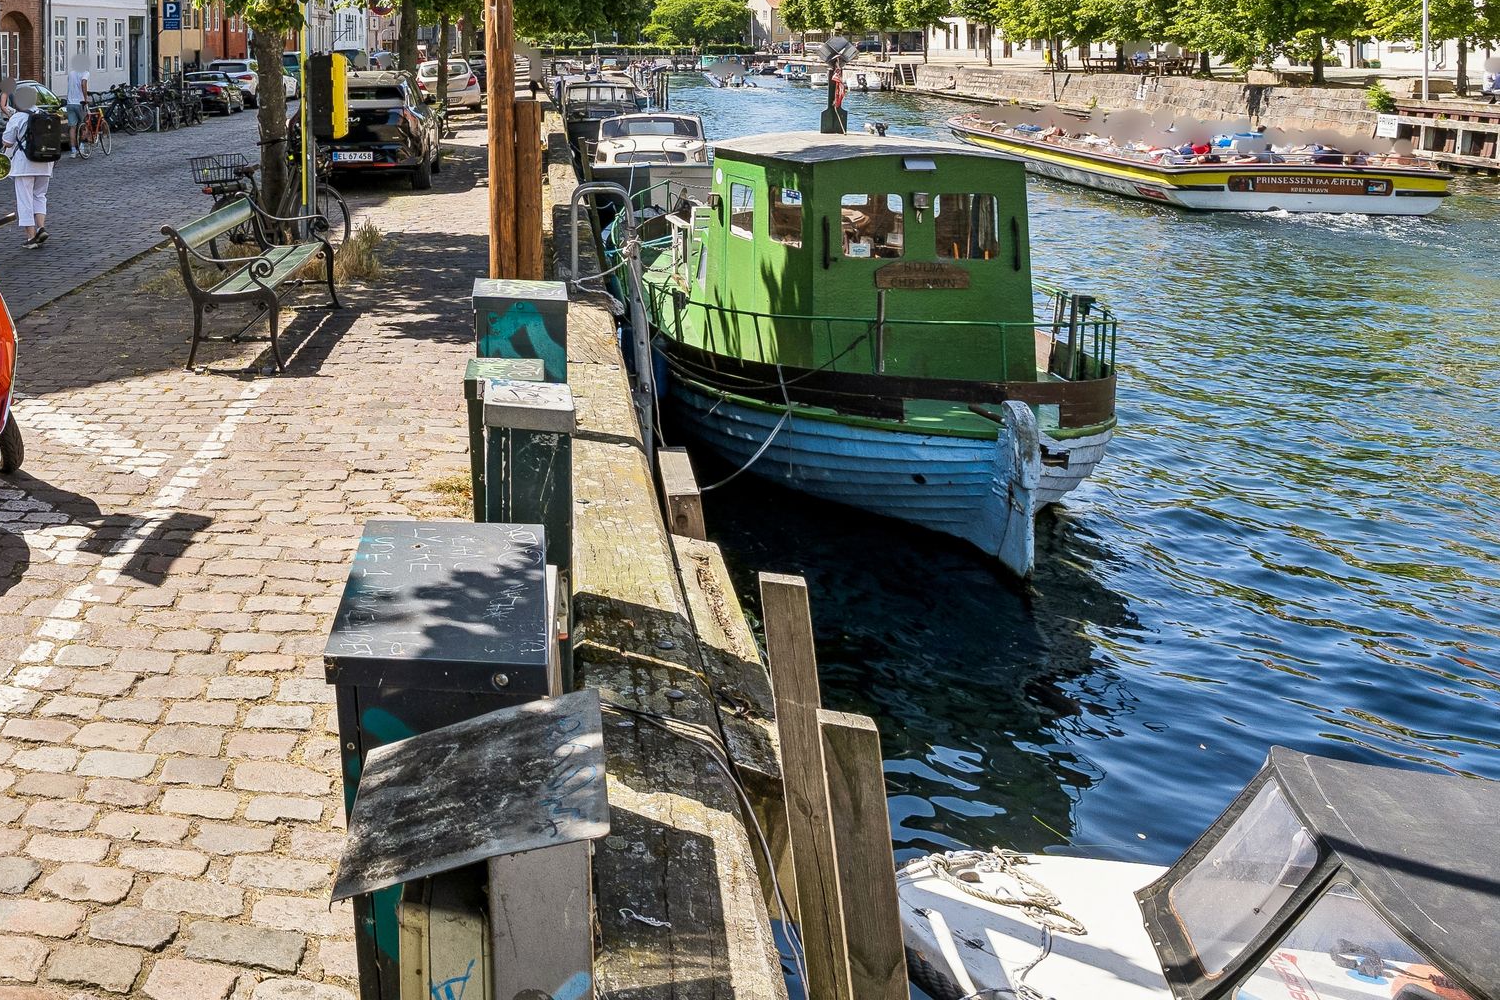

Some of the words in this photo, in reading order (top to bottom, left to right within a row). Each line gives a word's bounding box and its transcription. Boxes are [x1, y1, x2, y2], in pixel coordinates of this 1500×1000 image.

[166, 3, 176, 17] P
[337, 152, 347, 160] EL
[348, 152, 358, 160] 67
[358, 152, 373, 160] 458
[1256, 176, 1313, 185] PRINSESSEN
[1330, 178, 1364, 186] ÆRTEN
